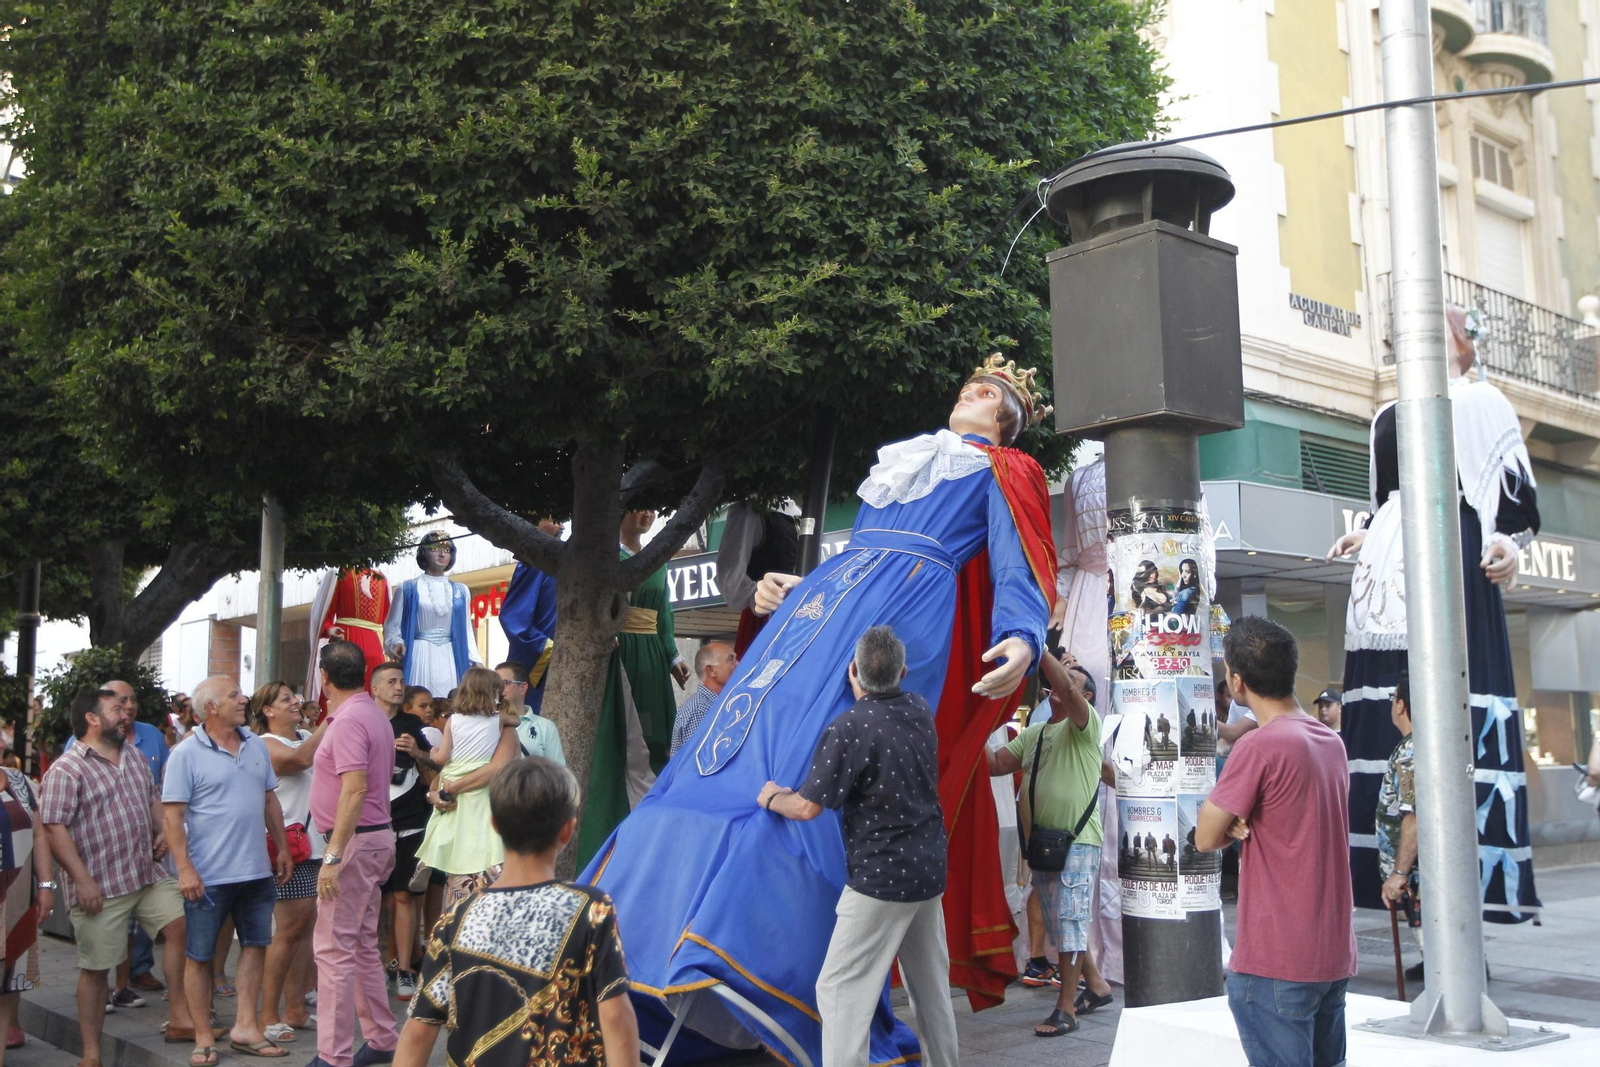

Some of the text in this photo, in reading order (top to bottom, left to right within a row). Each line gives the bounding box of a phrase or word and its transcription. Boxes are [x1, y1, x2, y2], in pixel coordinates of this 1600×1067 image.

[1152, 658, 1188, 669] 8-9-10
[1122, 688, 1157, 696] HOMBRES G
[1156, 761, 1174, 771] MAR
[1126, 806, 1162, 815] HOMBRES G
[1150, 882, 1159, 891] DE
